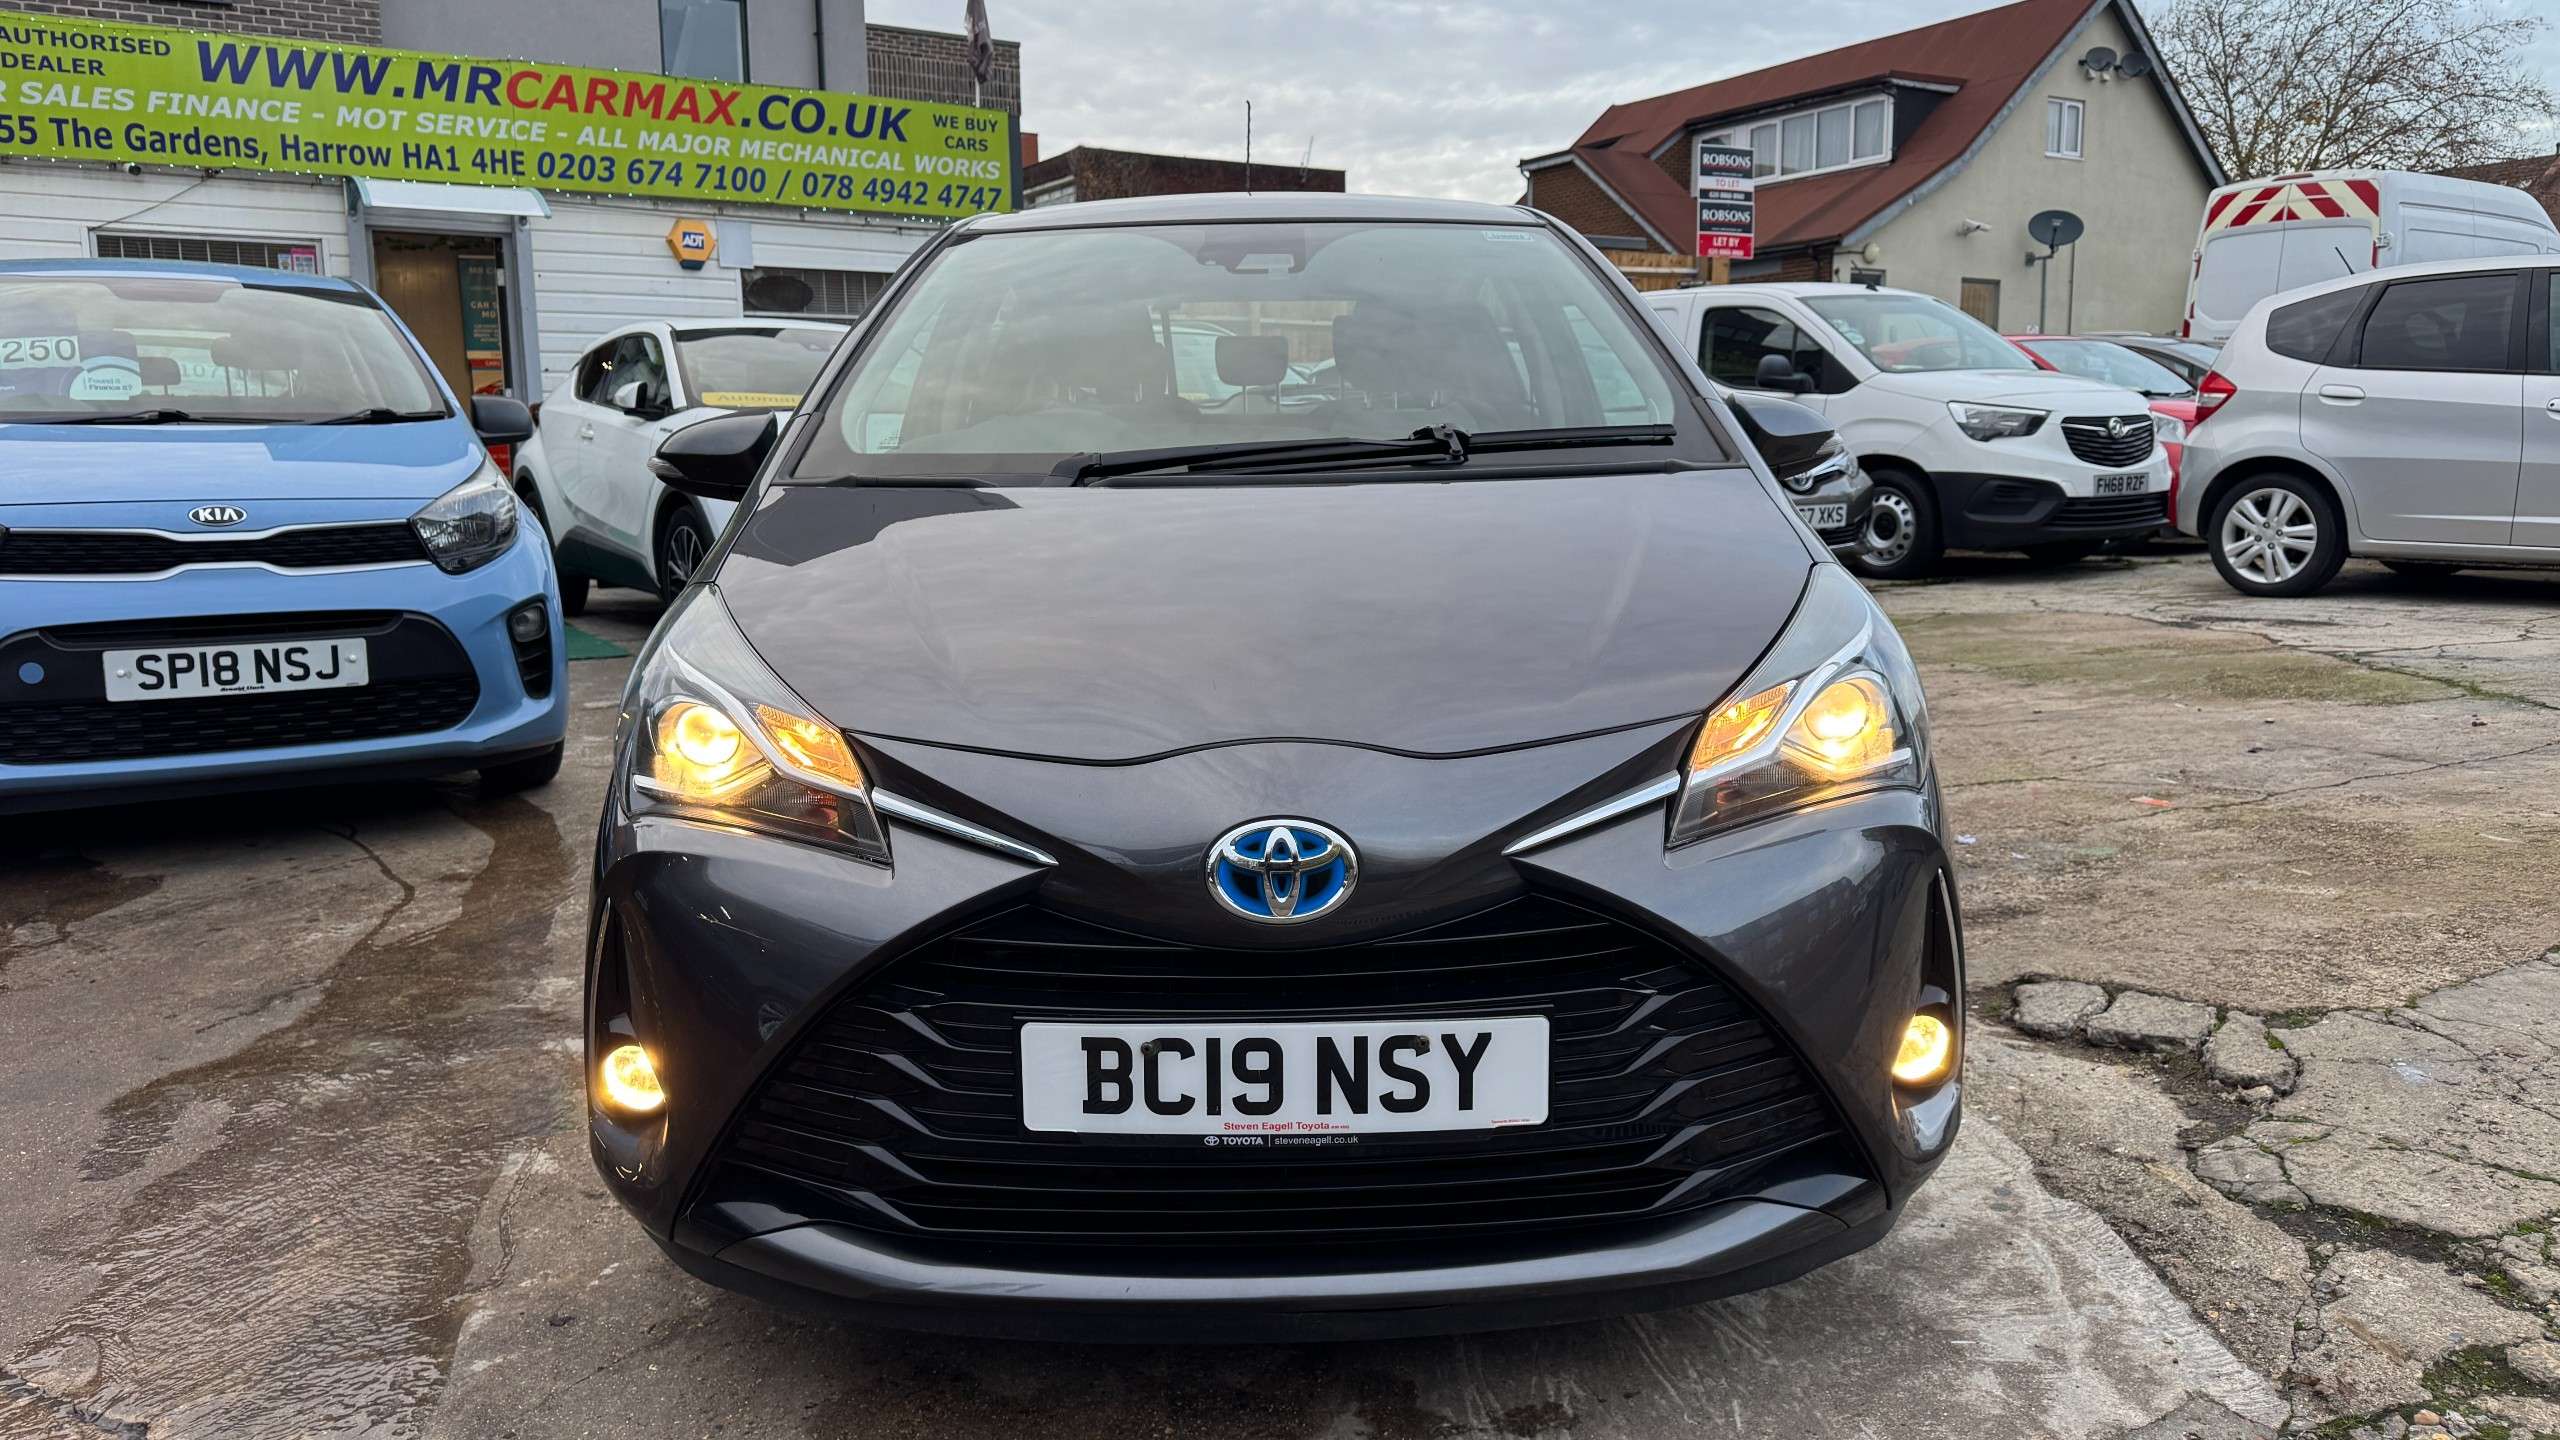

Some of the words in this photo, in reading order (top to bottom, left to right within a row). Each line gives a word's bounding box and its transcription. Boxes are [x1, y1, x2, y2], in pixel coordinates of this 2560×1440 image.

[0, 26, 171, 56] AUTHORISED
[1, 52, 106, 76] DEALER
[198, 41, 912, 142] WWW.MRCARMAX.CO.UK
[20, 81, 135, 111] SALES
[147, 91, 302, 124] FINANCE
[336, 106, 407, 131] MOT
[415, 112, 548, 142] SERVICE
[576, 126, 628, 149] ALL
[638, 131, 731, 157] MAJOR
[740, 140, 905, 172] MECHANICAL
[914, 154, 1001, 180] WORKS
[932, 113, 959, 129] WE
[965, 117, 998, 132] BUY
[944, 135, 988, 152] CARS
[48, 117, 113, 149] The
[124, 122, 268, 165] Gardens,
[280, 134, 392, 167] Harrow
[402, 142, 460, 172] HA1
[471, 148, 525, 176] 4HE
[537, 152, 616, 182] 0203
[627, 159, 683, 187] 674
[695, 163, 767, 193] 7100
[776, 169, 792, 199] /
[802, 172, 854, 200] 078
[863, 178, 929, 206] 4942
[937, 185, 1002, 211] 4747
[1702, 153, 1751, 168] ROBSONS
[1702, 209, 1751, 223] ROBSONS
[682, 233, 704, 247] ADT
[1712, 236, 1727, 247] LET
[1728, 237, 1741, 247] BY
[2, 338, 76, 363] 250
[2096, 477, 2124, 493] FH68
[2126, 475, 2145, 491] RZF
[199, 507, 240, 521] KIA
[1819, 506, 1844, 524] XKS
[135, 650, 240, 690] SP18
[253, 644, 340, 684] NSJ
[1080, 1034, 1284, 1116] BC19
[1316, 1032, 1493, 1115] NSY
[1223, 1122, 1259, 1131] Steven
[1262, 1121, 1293, 1132] Eagell
[1296, 1121, 1330, 1131] Toyota
[1222, 1136, 1264, 1145] TOYOTA
[1274, 1135, 1359, 1147] steveneagell.co.uk
